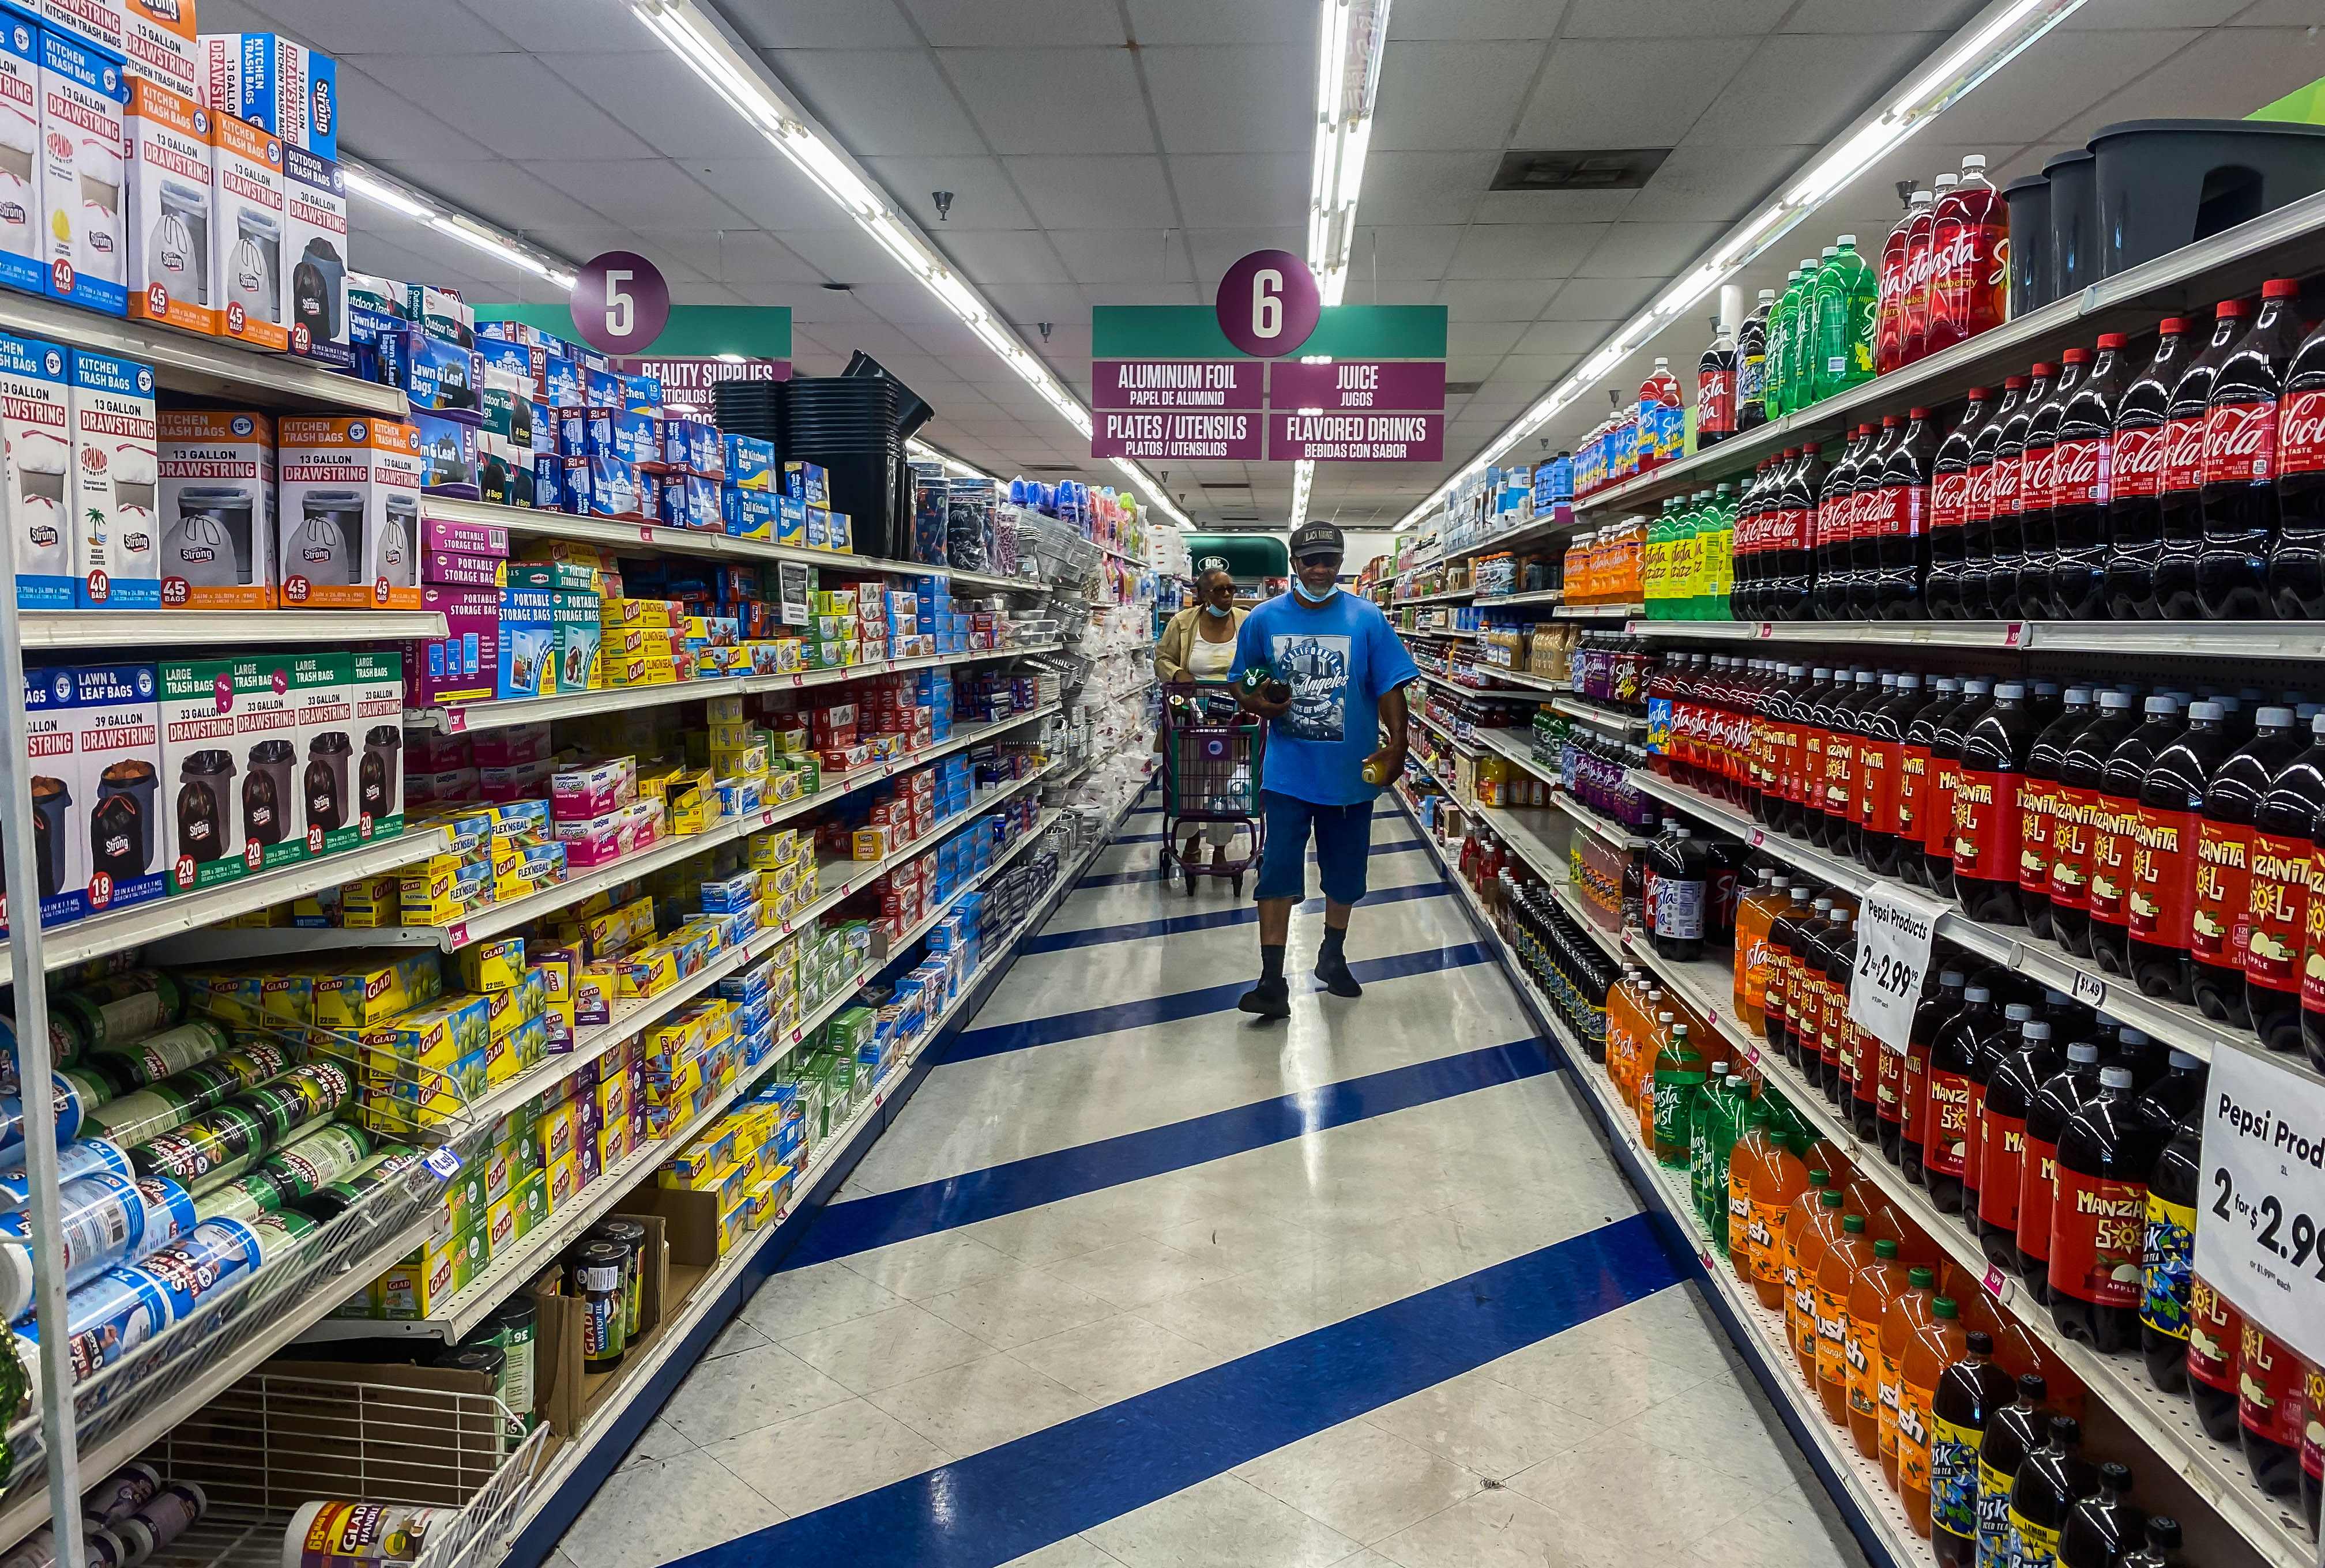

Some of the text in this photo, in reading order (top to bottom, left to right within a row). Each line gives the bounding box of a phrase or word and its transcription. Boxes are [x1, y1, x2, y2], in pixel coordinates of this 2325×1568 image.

[46, 38, 85, 65] KITCHEN
[46, 54, 96, 85] TRASH BAGS
[254, 38, 265, 90] KITCHEN
[62, 85, 106, 114] 13 GALLON
[142, 85, 180, 111] KITCHEN
[48, 95, 119, 141] DRAWSTRING
[144, 98, 191, 130] TRASH BAGS
[223, 119, 255, 141] KITCHEN
[157, 134, 197, 158] 13 GALLON
[223, 131, 265, 160] TRASH BAGS
[145, 142, 208, 183] DRAWSTRING
[288, 150, 322, 172] OUTDOOR
[235, 163, 270, 187] 13 GALLON
[289, 161, 330, 187] TRASH BAGS
[225, 172, 282, 209] DRAWSTRING
[301, 192, 336, 213] 30 GALLON
[291, 201, 345, 234] DRAWSTRING
[54, 268, 72, 282] 40
[55, 280, 71, 292] BAGS
[605, 270, 633, 336] 5
[1252, 269, 1284, 338] 6
[230, 307, 243, 323] 45
[425, 316, 458, 340] Outdoor Trash
[79, 357, 118, 375] KITCHEN
[411, 359, 435, 379] Lawn
[445, 368, 463, 387] Leaf
[642, 363, 773, 387] BEAUTY SUPPLIES
[79, 371, 129, 390] TRASH BAGS
[411, 376, 432, 396] Bags
[1118, 365, 1237, 389] ALUMINUM FOIL
[1336, 365, 1379, 390] JUICE
[660, 387, 706, 404] RTÍCULOS
[1130, 391, 1225, 406] PAPEL DE ALUMINIO
[1340, 392, 1374, 407] JUGOS
[95, 399, 141, 416] 13 GALLON
[82, 413, 153, 439] DRAWSTRING
[1107, 415, 1247, 440] PLATES / UTENSILS
[1286, 417, 1427, 442] FLAVORED DRINKS
[615, 427, 654, 446] Waste Basket
[738, 448, 767, 463] Tall Kitchen
[1125, 442, 1227, 457] PLATOS / UTENSILIOS
[1304, 444, 1407, 459] BEBIDAS CON SABOR
[159, 463, 255, 477] DRAWSTRING
[285, 467, 367, 480] DRAWSTRING
[455, 530, 484, 541] PORTABLE
[444, 540, 485, 551] STORAGE BAG
[458, 557, 494, 571] PORTABLE
[89, 576, 106, 591] 40
[288, 579, 306, 593] 45
[445, 570, 494, 584] STORAGE BAG
[464, 594, 496, 604] PORTABLE
[514, 593, 549, 606] PORTABLE
[567, 595, 599, 609] PORTABLE
[450, 605, 496, 615] STORAGE BAG
[499, 609, 550, 621] STORAGE BAGS
[554, 609, 600, 623] STORAGE BAGS
[626, 604, 639, 620] GLAD
[466, 659, 477, 669] XXL
[1284, 647, 1338, 665] CALIFORNIA
[166, 668, 191, 681] LARGE
[296, 660, 316, 672] LARGE
[449, 662, 457, 670] XL
[78, 672, 117, 686] LAWN &
[1298, 670, 1349, 696] Angeles
[80, 684, 133, 700] LEAF BAGS
[308, 694, 341, 706] 33 GALLON
[95, 713, 143, 728] 39 GALLON
[180, 706, 221, 719] 33 GALLON
[299, 708, 349, 724] DRAWSTRING
[82, 728, 155, 751] DRAWSTRING
[170, 721, 233, 740] DRAWSTRING
[178, 861, 194, 876] 20
[498, 858, 515, 875] GLAD
[93, 879, 109, 894] 18
[1868, 899, 1928, 940] Pepsi Products
[1860, 945, 1871, 977] 2
[2079, 975, 2100, 998] $1.49
[2218, 1092, 2325, 1170] Pepsi Prod
[2212, 1167, 2233, 1223] 2
[2235, 1193, 2249, 1216] for
[2107, 1283, 2136, 1293] APPLE
[2277, 1277, 2291, 1292] each
[596, 1317, 605, 1350] WAVETOP
[1819, 1343, 1844, 1359] Orange
[1978, 1499, 2010, 1521] risk
[343, 1506, 367, 1551] GLAD
[1983, 1522, 1995, 1531] ICED
[309, 1530, 326, 1550] 65
